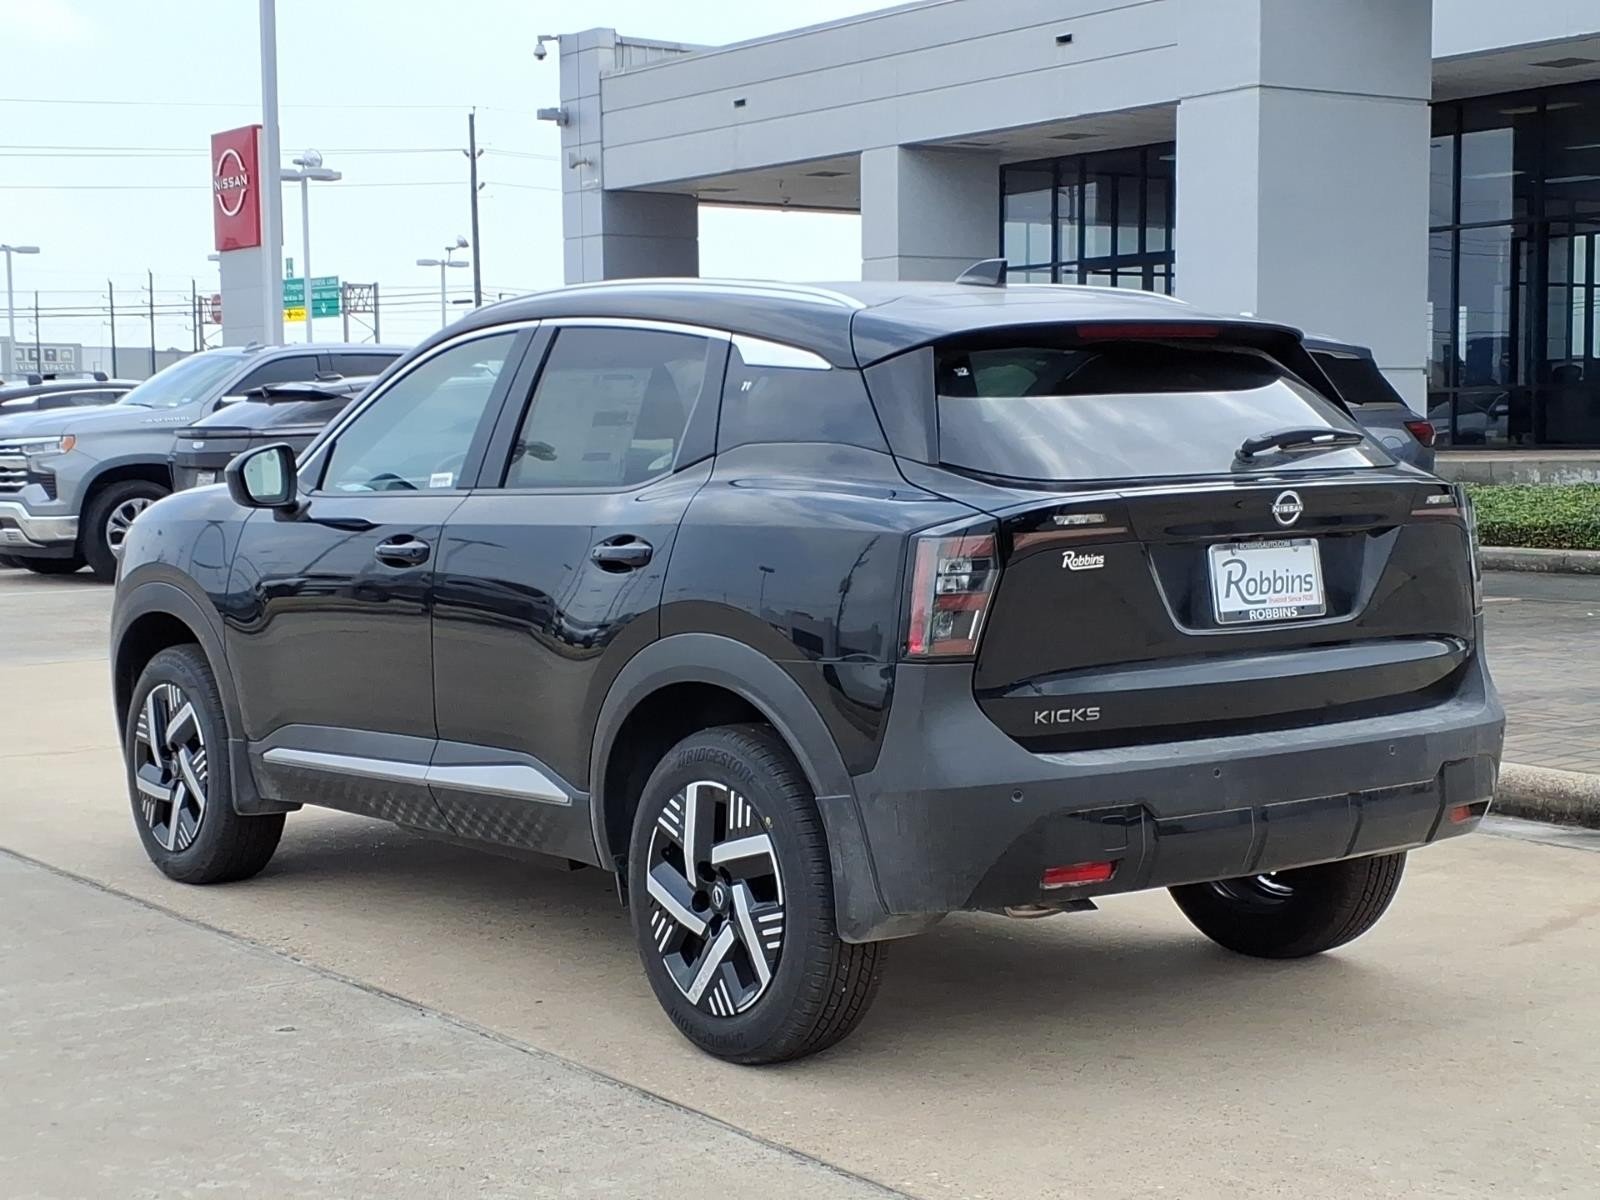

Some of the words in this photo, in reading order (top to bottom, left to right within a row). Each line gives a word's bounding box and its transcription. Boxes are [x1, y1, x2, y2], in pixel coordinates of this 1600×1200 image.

[214, 174, 248, 191] NISSAN
[1272, 503, 1303, 513] NISSAN
[1062, 550, 1104, 571] Robbins
[1221, 558, 1314, 605] Robbins
[1248, 606, 1298, 621] ROBBINS
[1034, 706, 1100, 725] KICKS
